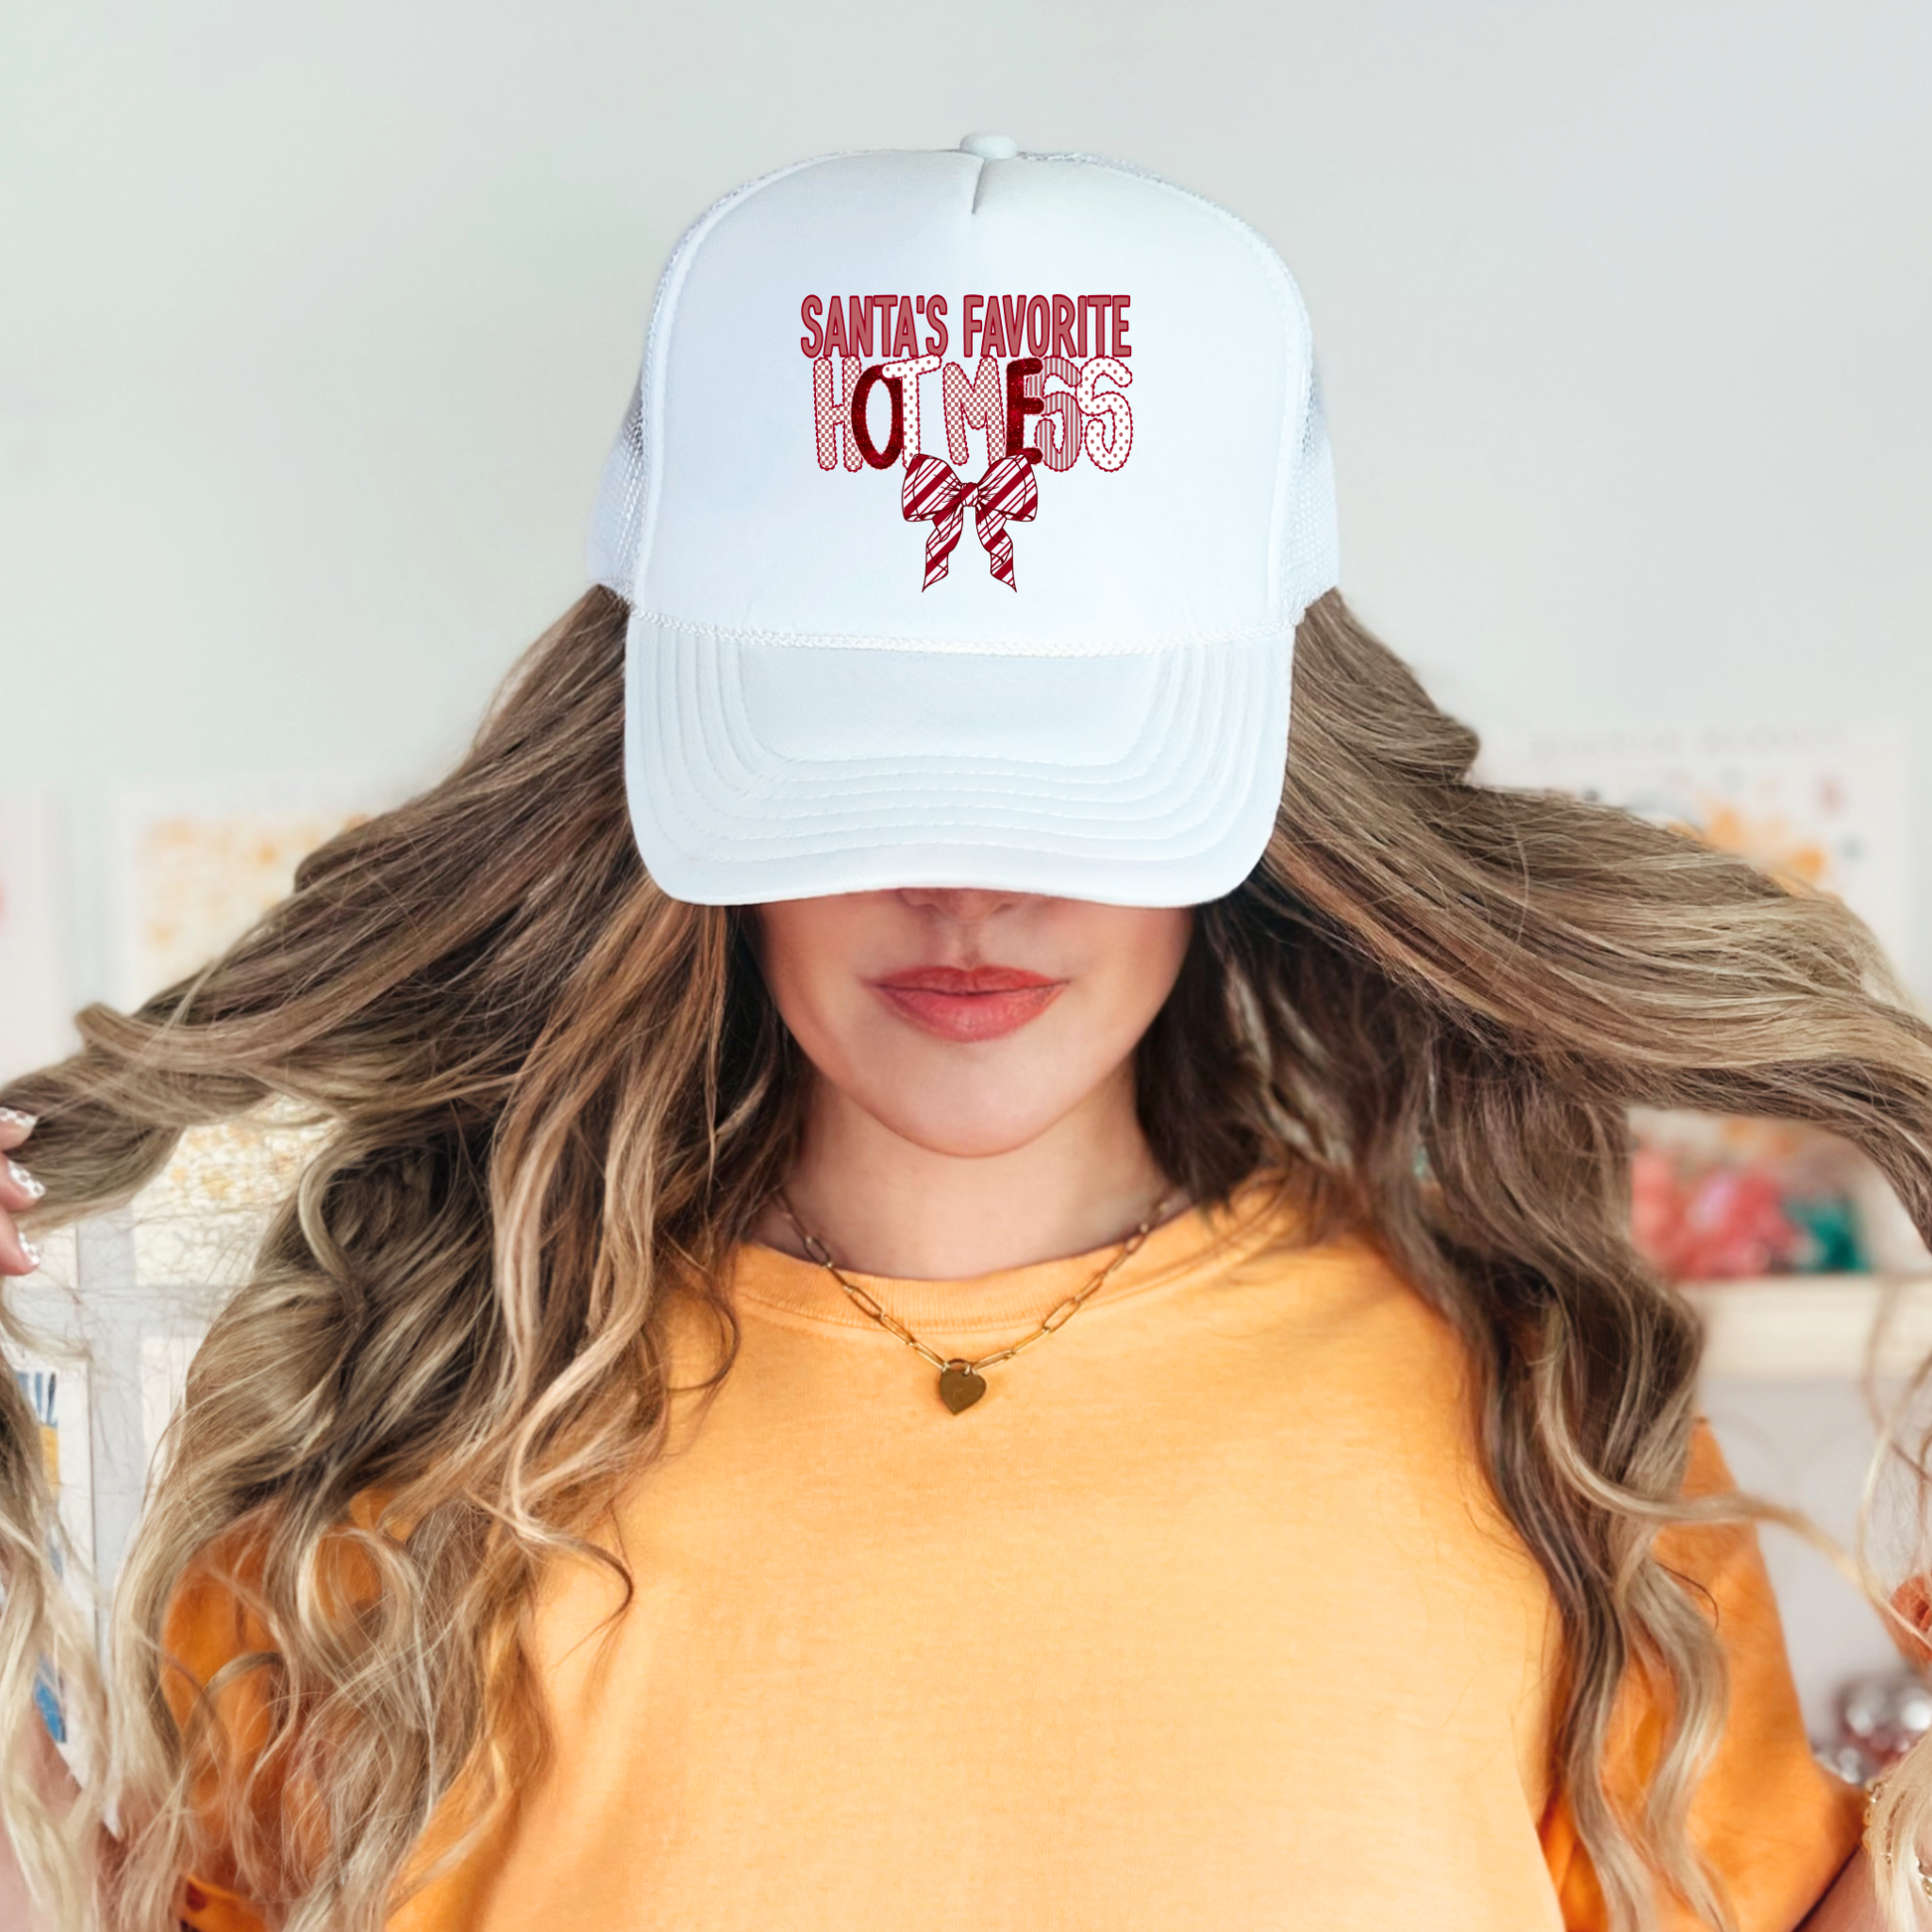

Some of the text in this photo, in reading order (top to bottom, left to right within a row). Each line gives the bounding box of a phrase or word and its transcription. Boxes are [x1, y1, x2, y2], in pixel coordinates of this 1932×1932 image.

[801, 294, 1132, 358] SANTA'S FAVORITE
[813, 354, 1133, 471] HOT MESS
